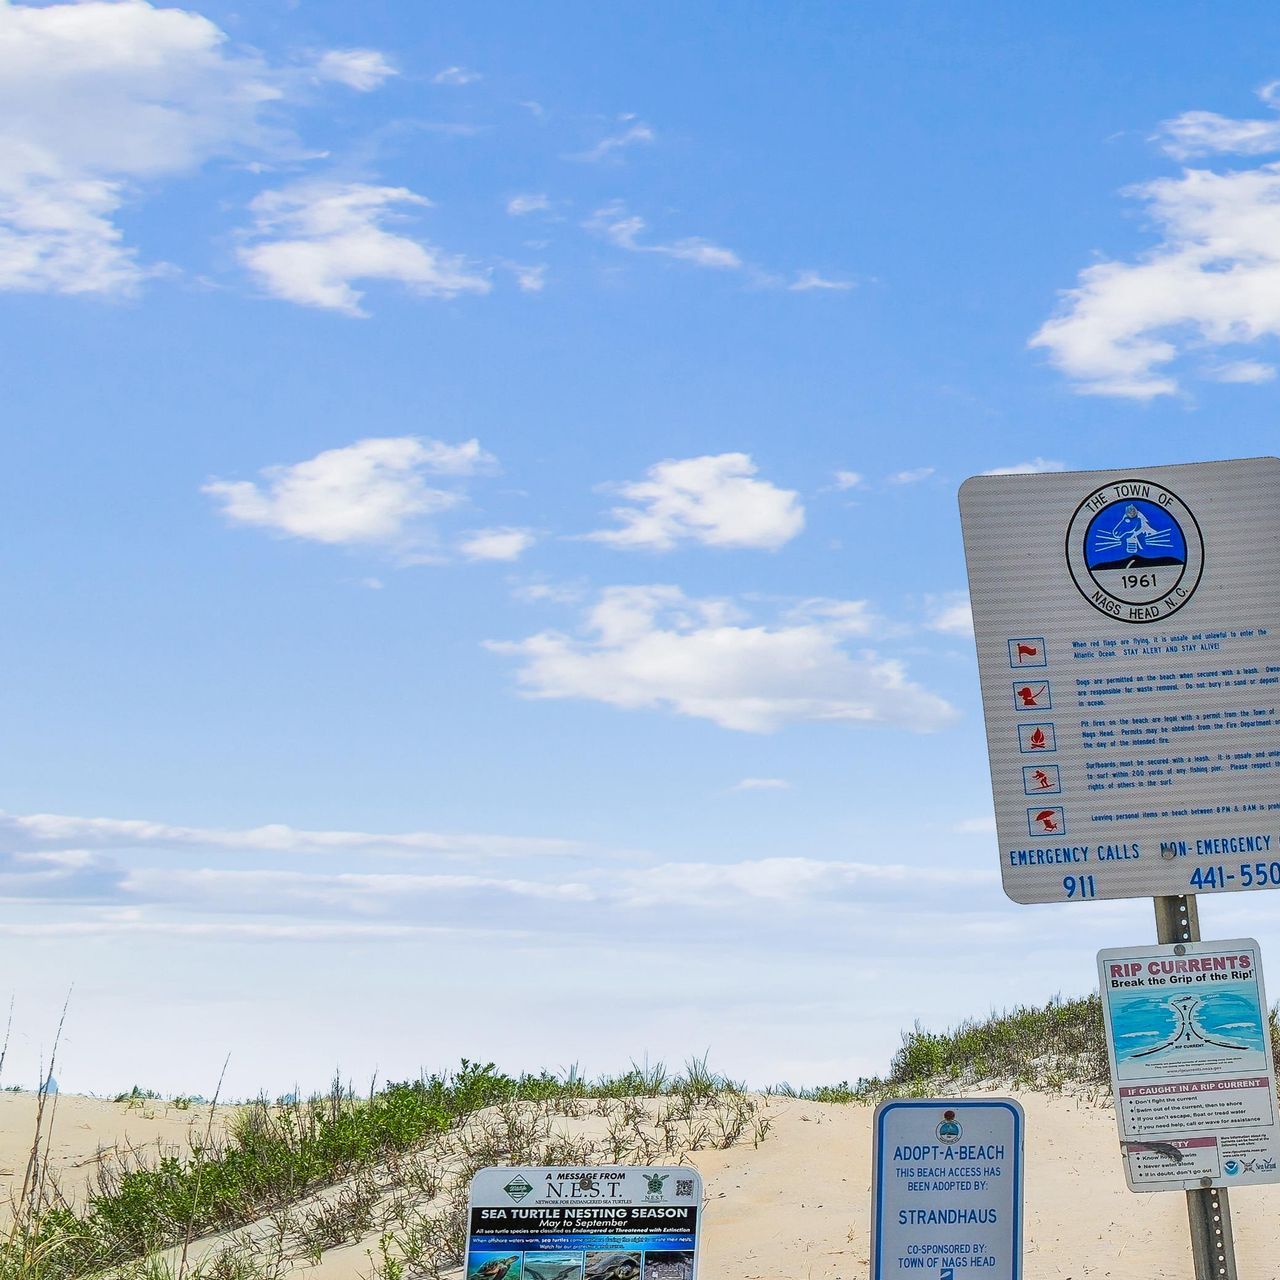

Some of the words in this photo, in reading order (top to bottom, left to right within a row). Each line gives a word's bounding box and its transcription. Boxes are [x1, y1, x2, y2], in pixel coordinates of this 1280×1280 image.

[1086, 492, 1108, 513] THE
[1114, 485, 1150, 499] TOWN
[1158, 493, 1174, 508] OF
[1121, 574, 1158, 590] 1961
[1092, 590, 1121, 616] NAGS
[1129, 606, 1160, 620] HEAD
[1009, 846, 1089, 866] EMERGENCY
[1097, 843, 1139, 860] CALLS
[1062, 875, 1094, 898] 911
[1109, 962, 1142, 977] RIP
[1147, 954, 1250, 975] CURRENTS
[1111, 978, 1144, 987] Break
[1148, 976, 1166, 985] the
[1169, 974, 1192, 985] Grip
[1195, 973, 1206, 981] of
[1211, 971, 1227, 980] the
[1230, 970, 1252, 980] Rip!
[1139, 1086, 1177, 1095] CAUGHT
[1217, 1079, 1260, 1089] CURRENT
[893, 1145, 1004, 1160] ADOPT-A-BEACH
[896, 1168, 913, 1177] THIS
[917, 1168, 945, 1176] BEACH
[948, 1167, 980, 1176] ACCESS
[984, 1167, 1000, 1176] HAS
[546, 1182, 623, 1197] N.E.S.T.
[907, 1181, 929, 1190] BEEN
[932, 1181, 971, 1190] ADOPTED
[974, 1181, 988, 1190] BY:
[481, 1209, 507, 1218] SEA
[511, 1209, 559, 1218] TURTLE
[564, 1209, 627, 1217] NESTING
[631, 1208, 688, 1217] SEASON
[898, 1209, 996, 1224] STRANDHAUS
[538, 1219, 561, 1228] May
[575, 1219, 627, 1228] September
[907, 1244, 970, 1253] CO-SPONSORED
[973, 1244, 987, 1253] BY:
[898, 1257, 923, 1267] TOWN
[927, 1257, 938, 1267] OF
[941, 1257, 967, 1266] NAGS
[970, 1257, 995, 1266] HEAD
